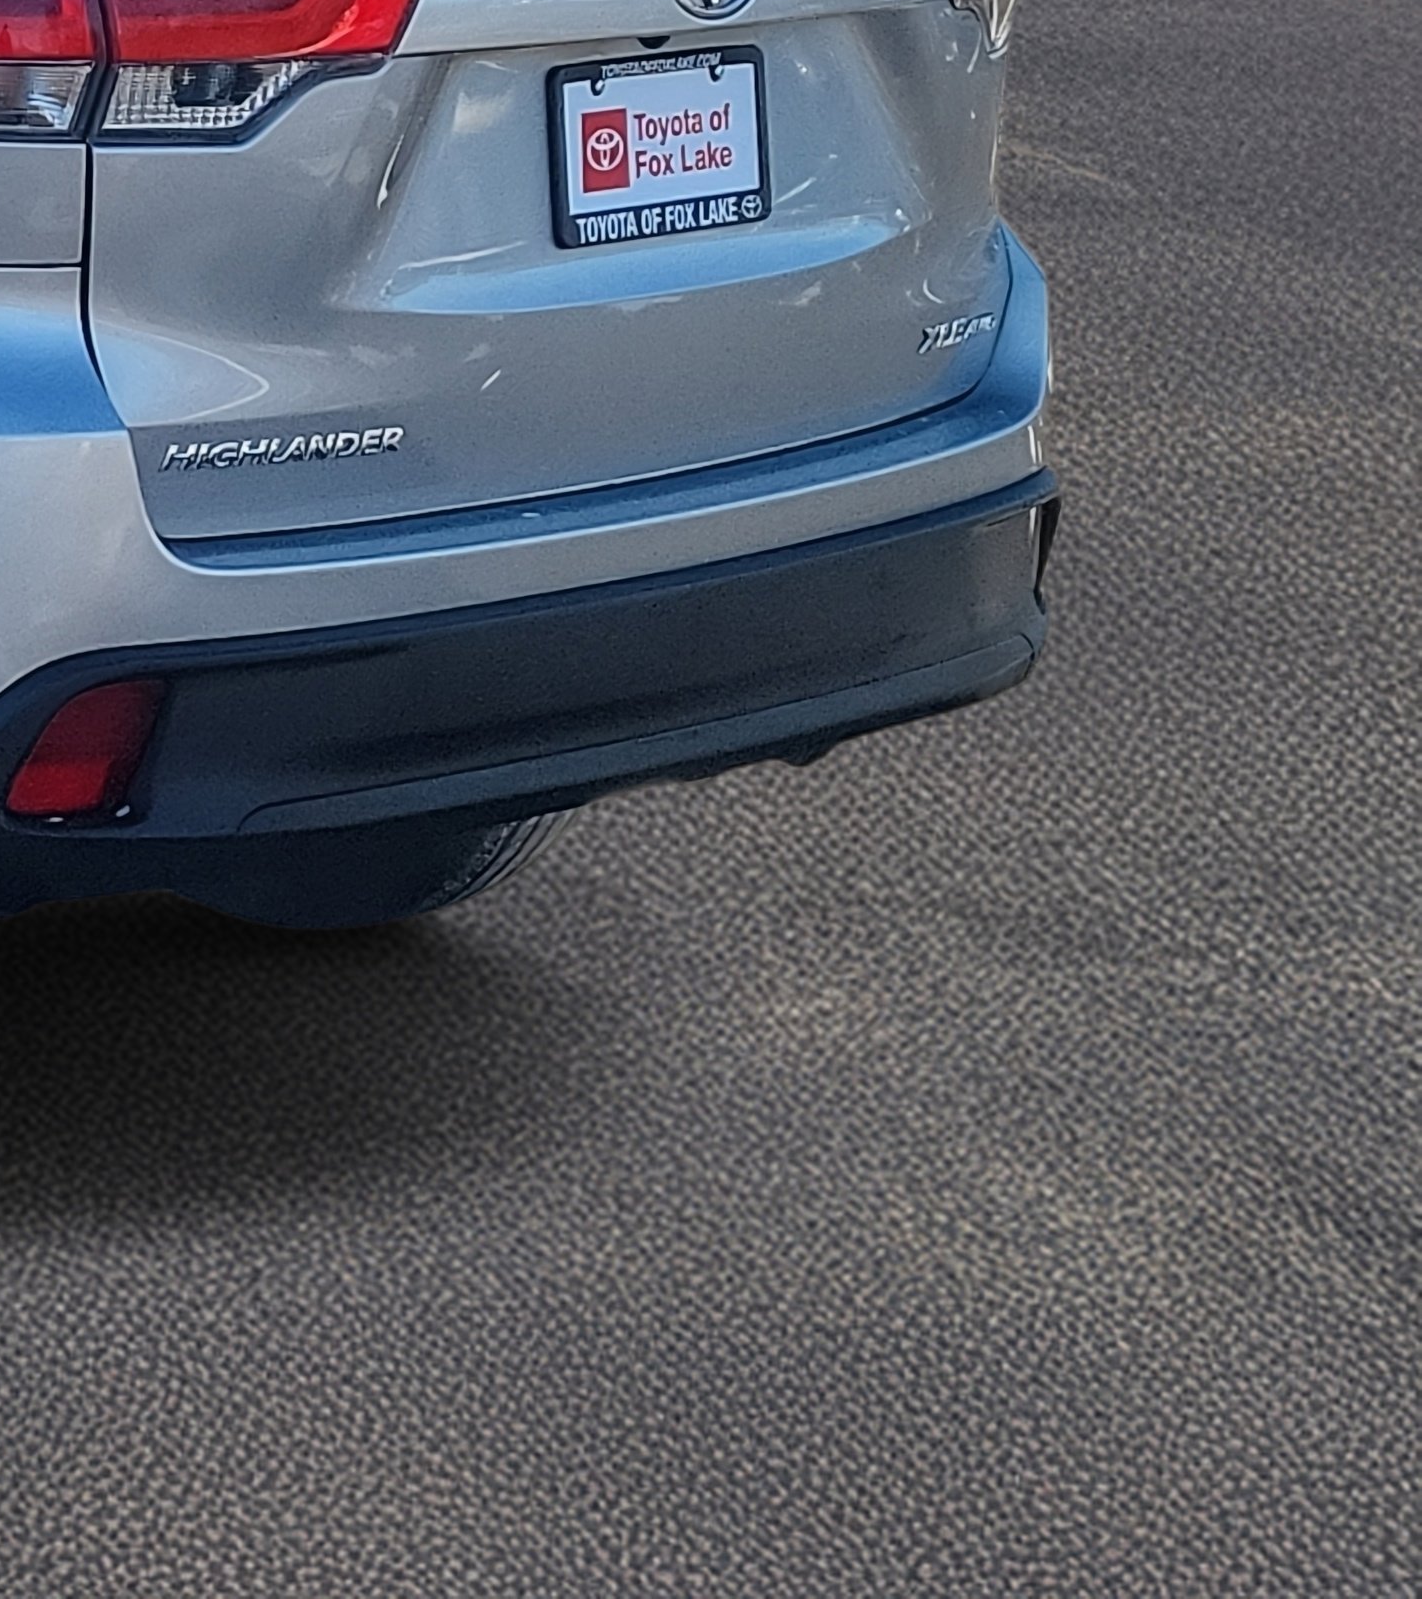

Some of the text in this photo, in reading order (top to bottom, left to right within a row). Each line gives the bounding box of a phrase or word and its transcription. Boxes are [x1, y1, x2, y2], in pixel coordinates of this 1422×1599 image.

[633, 102, 731, 145] Toyota of
[634, 141, 733, 179] Fox Lake
[576, 196, 740, 244] TOYOTA OF FOX LAKE
[159, 426, 405, 472] HIGHLANDER
